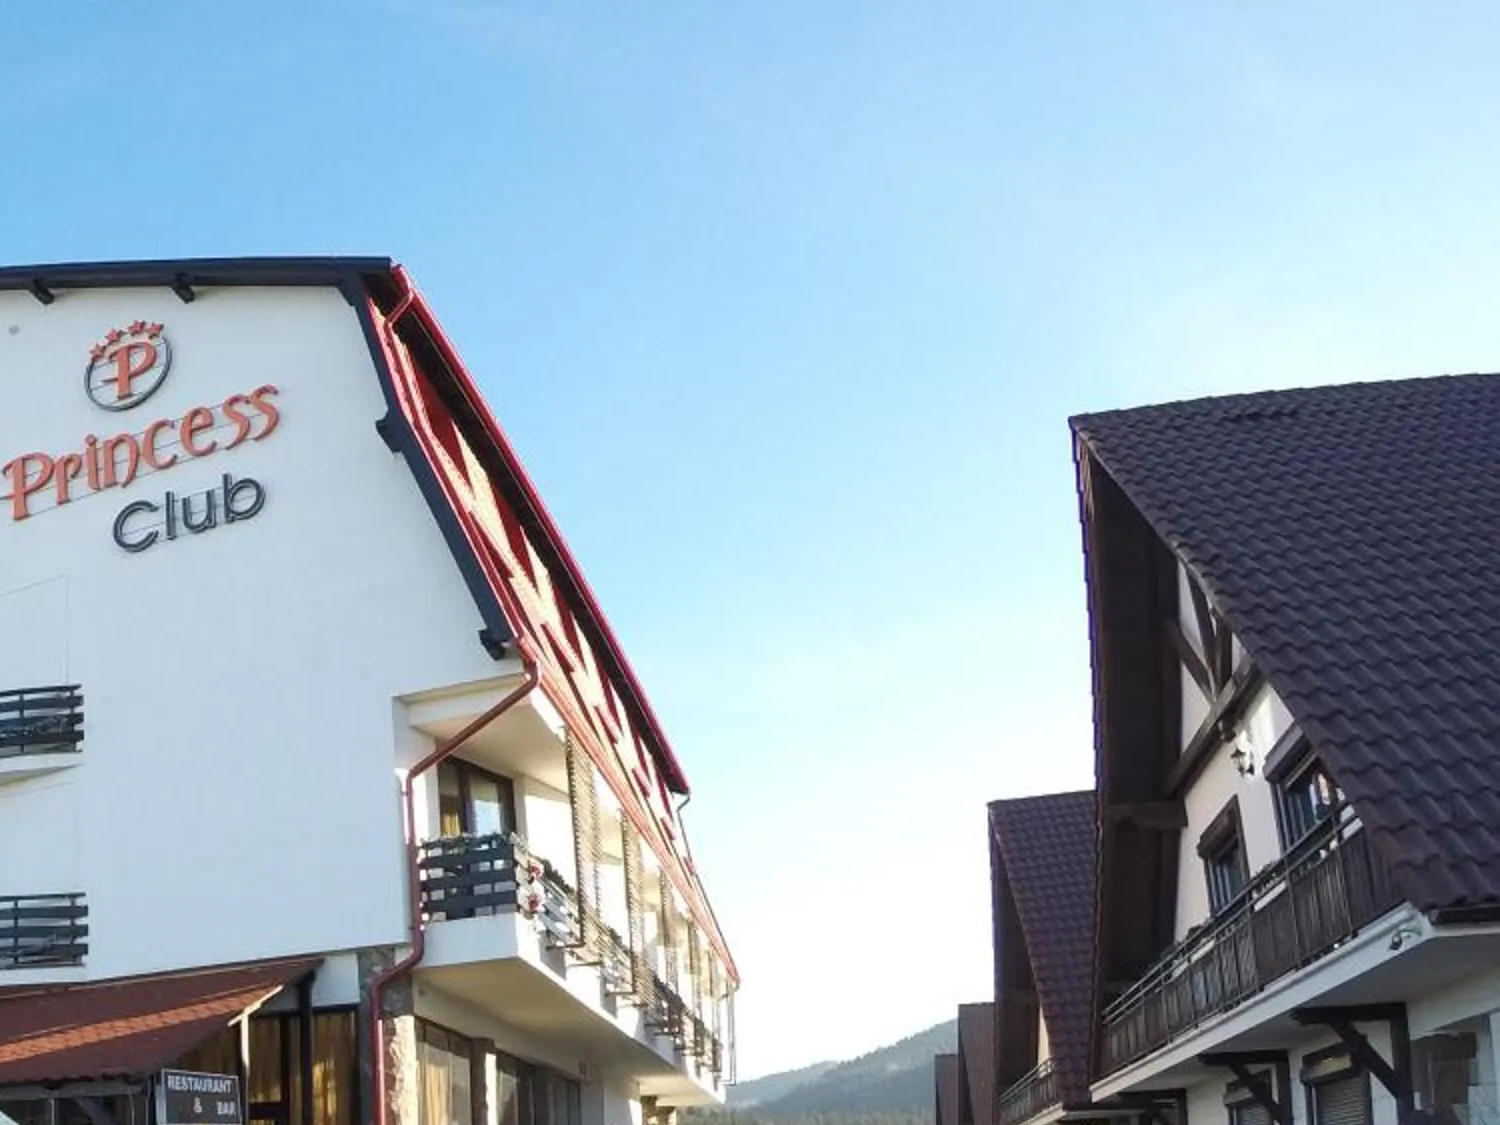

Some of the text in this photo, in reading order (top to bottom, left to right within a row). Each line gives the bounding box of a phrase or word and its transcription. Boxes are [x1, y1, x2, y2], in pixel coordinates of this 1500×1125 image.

[100, 341, 158, 400] P
[113, 472, 265, 552] Club
[167, 1075, 232, 1093] RESTAURANT
[193, 1097, 237, 1116] & BAR
